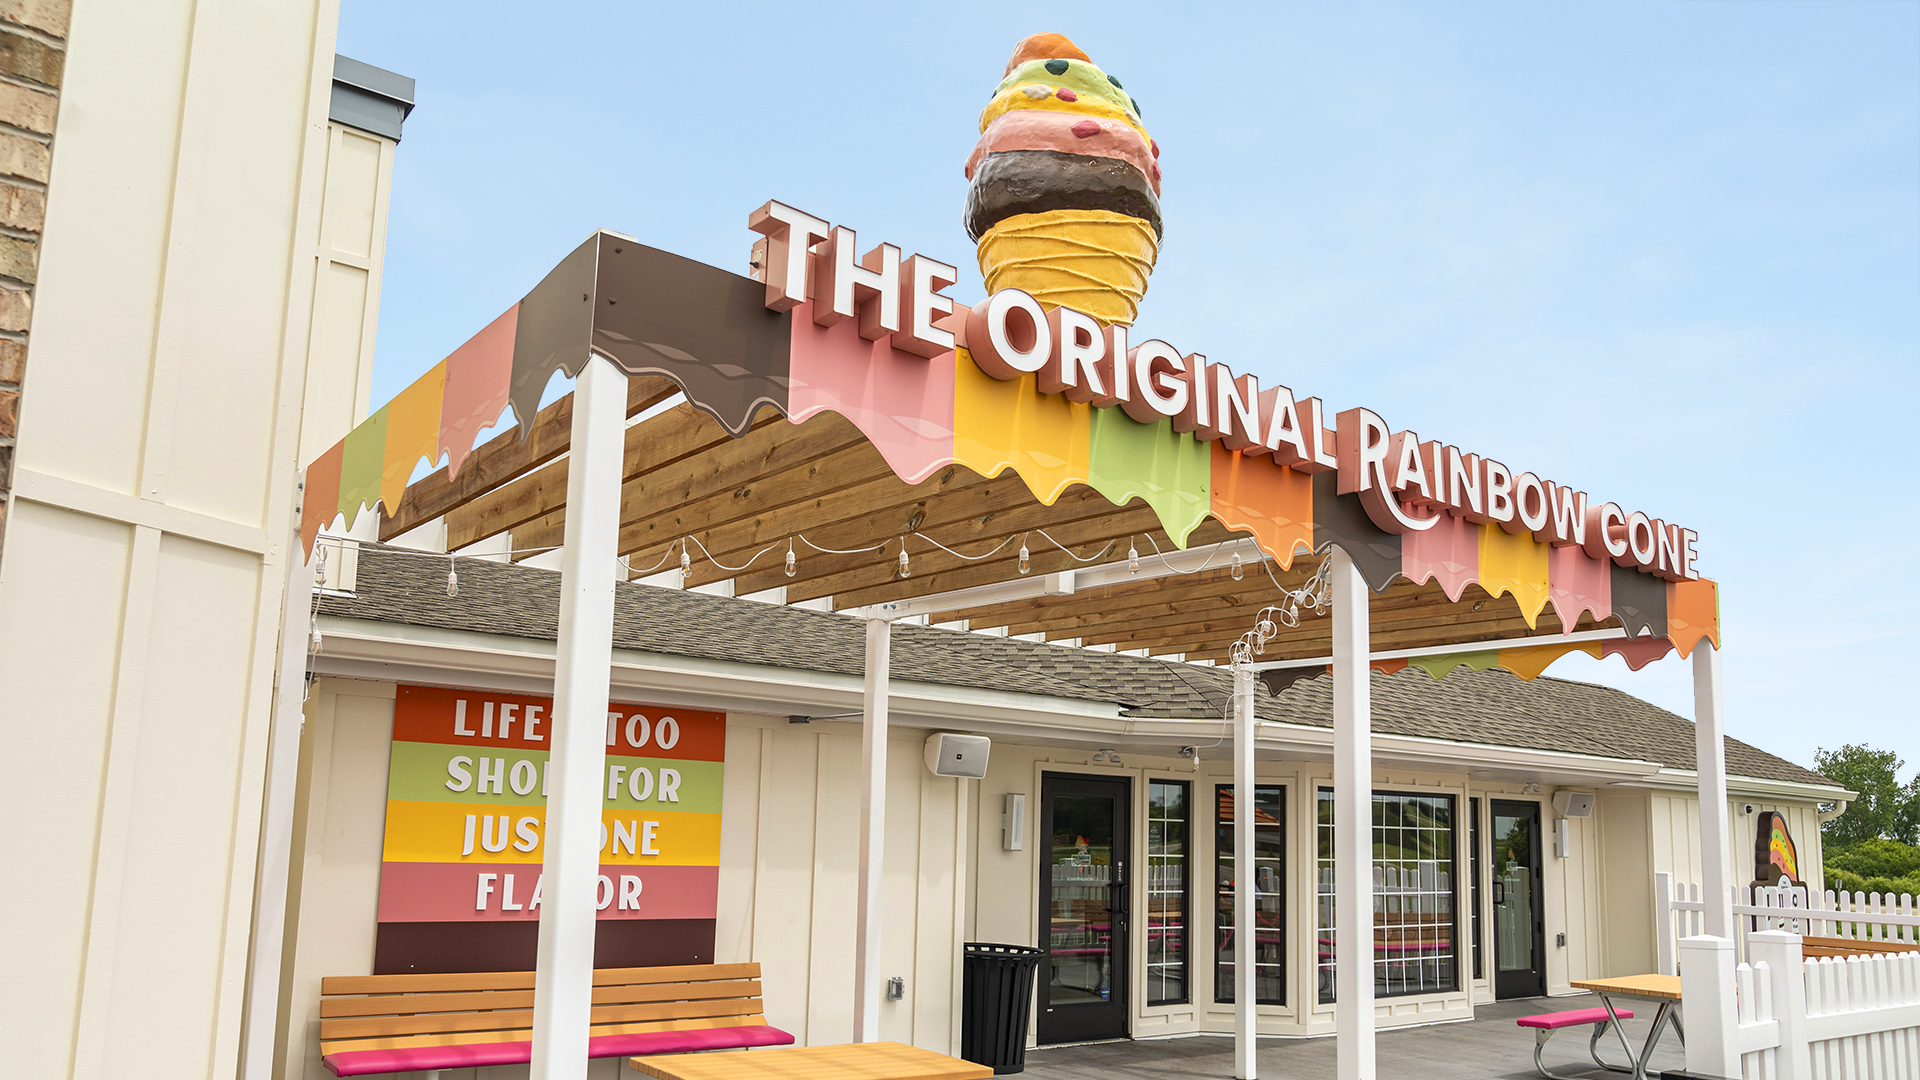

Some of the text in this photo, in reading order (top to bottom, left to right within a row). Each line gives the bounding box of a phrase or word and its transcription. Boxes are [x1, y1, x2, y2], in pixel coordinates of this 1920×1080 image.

[769, 200, 1699, 581] THE ORIGINAL RAINBOW CONE
[453, 699, 681, 751] LIFE TOO
[444, 755, 682, 803] SHO FOR
[461, 814, 547, 857] JUS
[475, 873, 643, 912] FLOR
